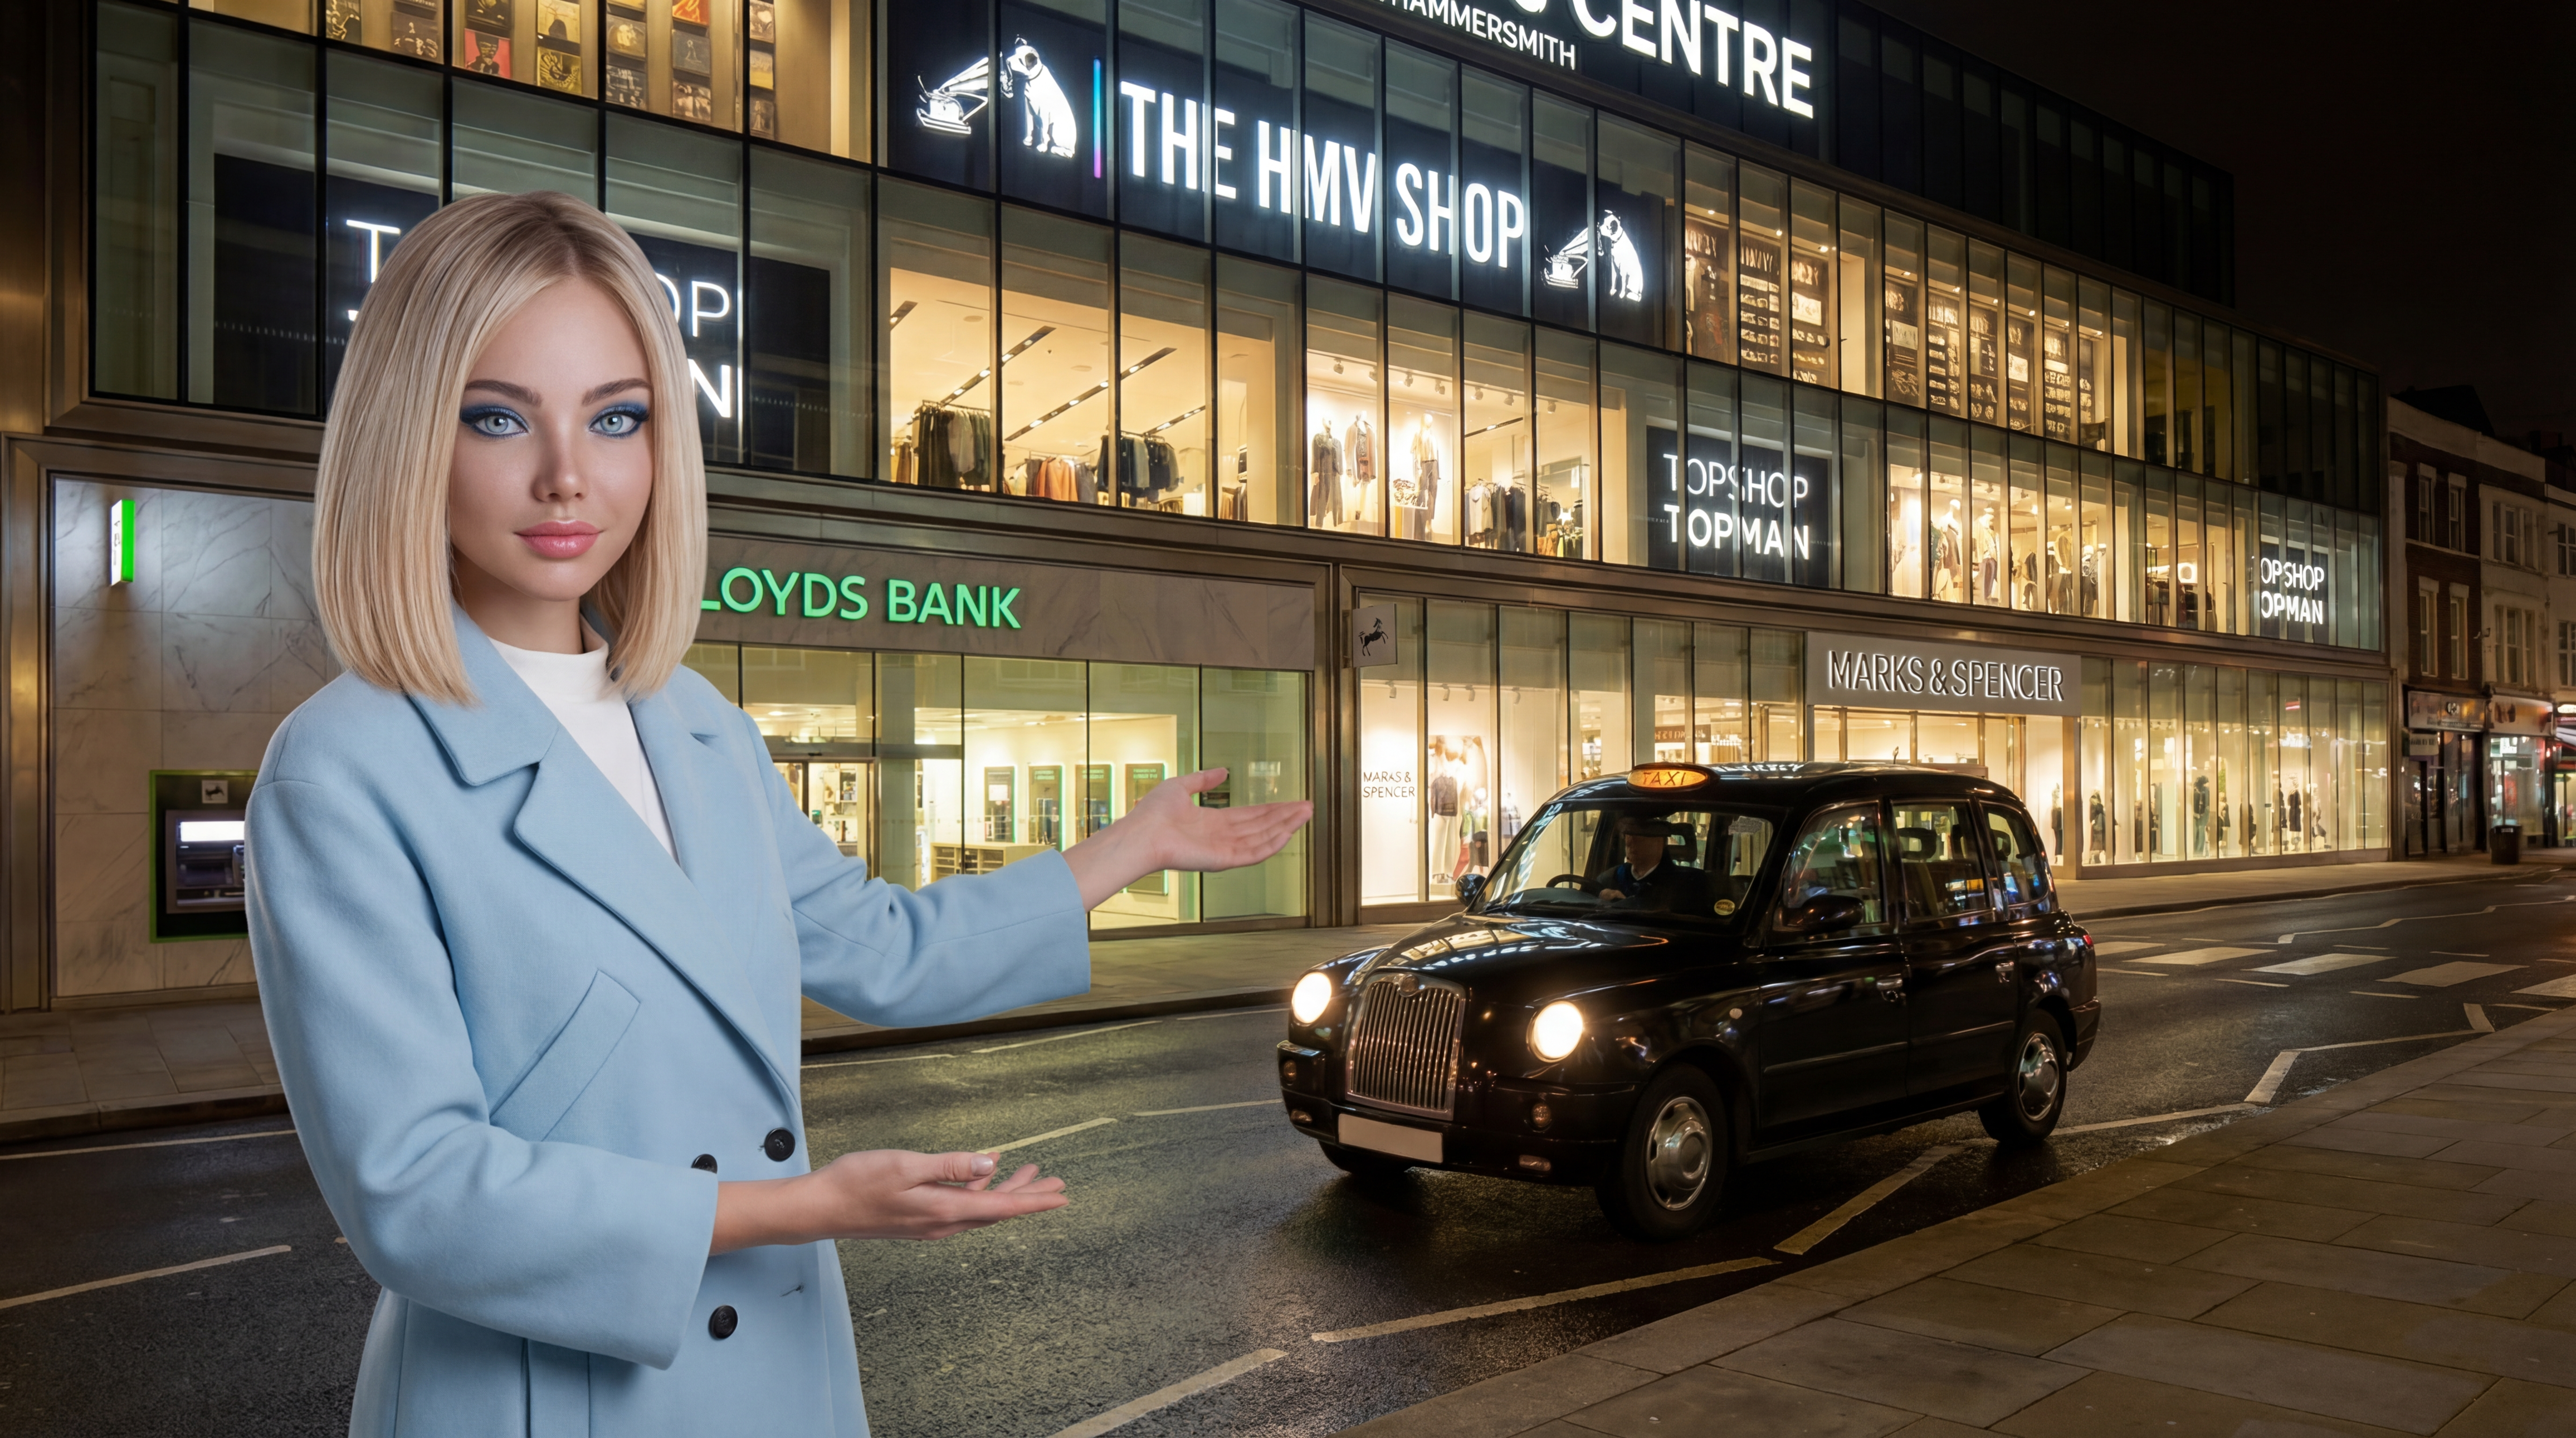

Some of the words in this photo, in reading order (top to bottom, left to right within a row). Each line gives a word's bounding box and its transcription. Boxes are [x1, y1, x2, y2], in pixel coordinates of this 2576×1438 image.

[1392, 0, 1575, 70] AMMERSMITH
[1120, 81, 1236, 199] THE
[1258, 120, 1376, 233] HMV
[1396, 163, 1525, 268] SHOP
[1663, 454, 1808, 508] TOPSHOP
[1663, 504, 1809, 560] TOPMAN
[887, 579, 1022, 629] BANK
[1828, 650, 1925, 694] MARKS
[1929, 659, 1949, 695] &
[1951, 659, 2065, 702] SPENCER
[1363, 786, 1415, 798] SPENCER
[1405, 771, 1411, 782] &
[1643, 771, 1686, 785] TAXI
